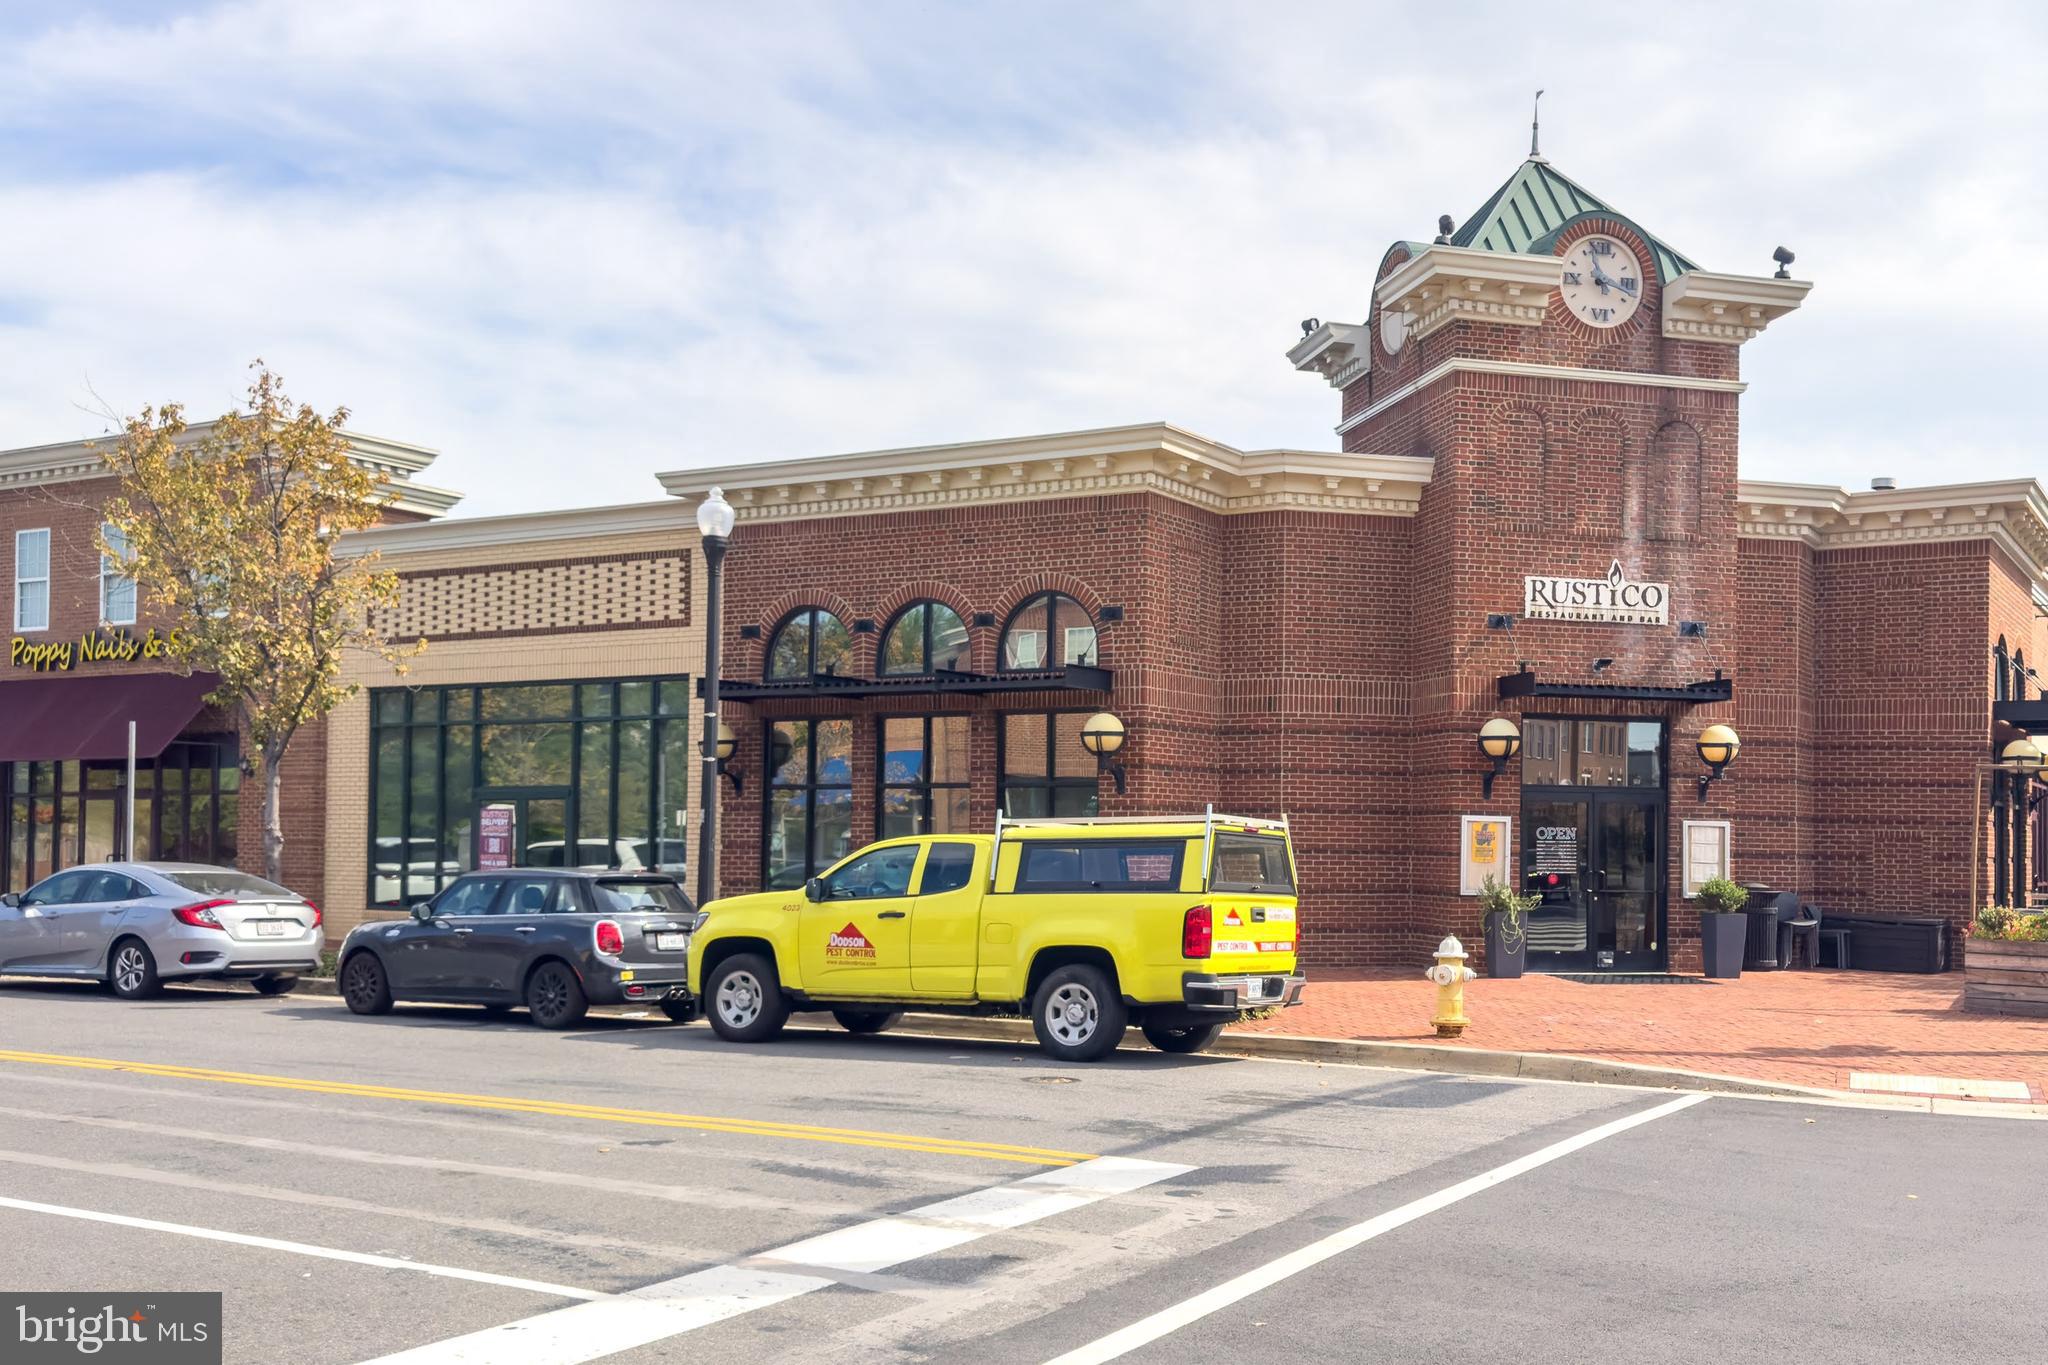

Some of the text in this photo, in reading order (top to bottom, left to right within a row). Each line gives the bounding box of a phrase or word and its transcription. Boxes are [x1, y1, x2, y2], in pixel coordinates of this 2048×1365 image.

[1563, 272, 1582, 285] IX
[1591, 308, 1610, 321] VI
[1530, 610, 1605, 621] RESTAURANT
[1611, 614, 1633, 622] AND
[11, 637, 72, 671] Poppy
[80, 630, 140, 662] Nails
[143, 628, 163, 657] &
[1536, 826, 1577, 840] OPEN
[831, 933, 865, 947] DODSON
[1217, 942, 1249, 951] PEST CONTROL
[825, 948, 876, 958] PEST CONTROL
